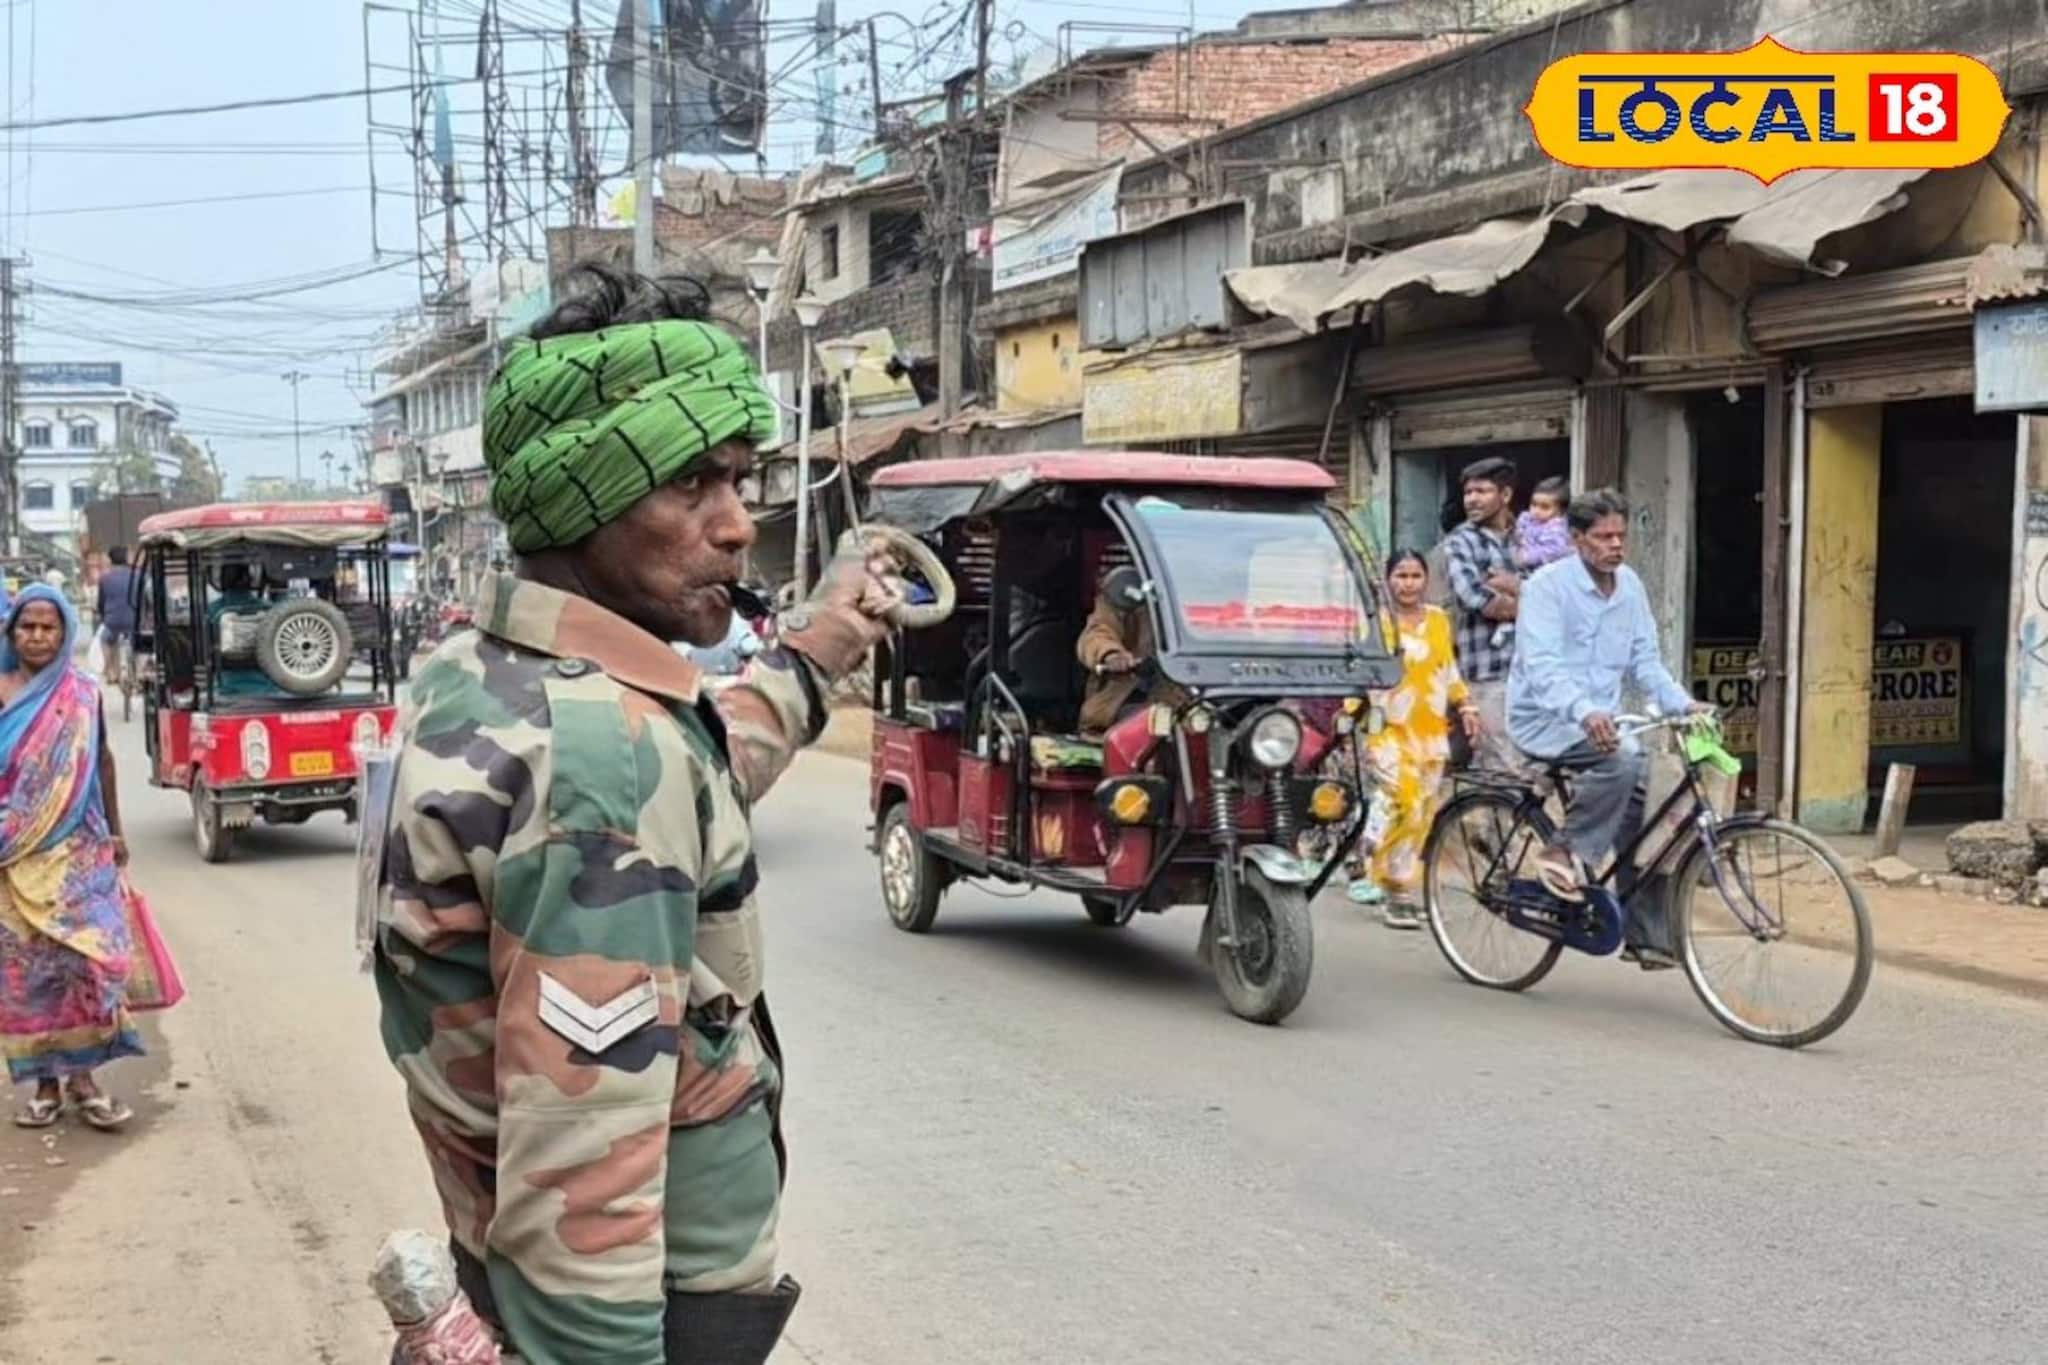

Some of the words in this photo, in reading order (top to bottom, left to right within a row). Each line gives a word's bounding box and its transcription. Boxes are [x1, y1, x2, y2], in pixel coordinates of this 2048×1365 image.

[1714, 651, 1759, 668] DEA
[1873, 644, 1921, 662] EAR
[1871, 670, 1957, 702] RORE
